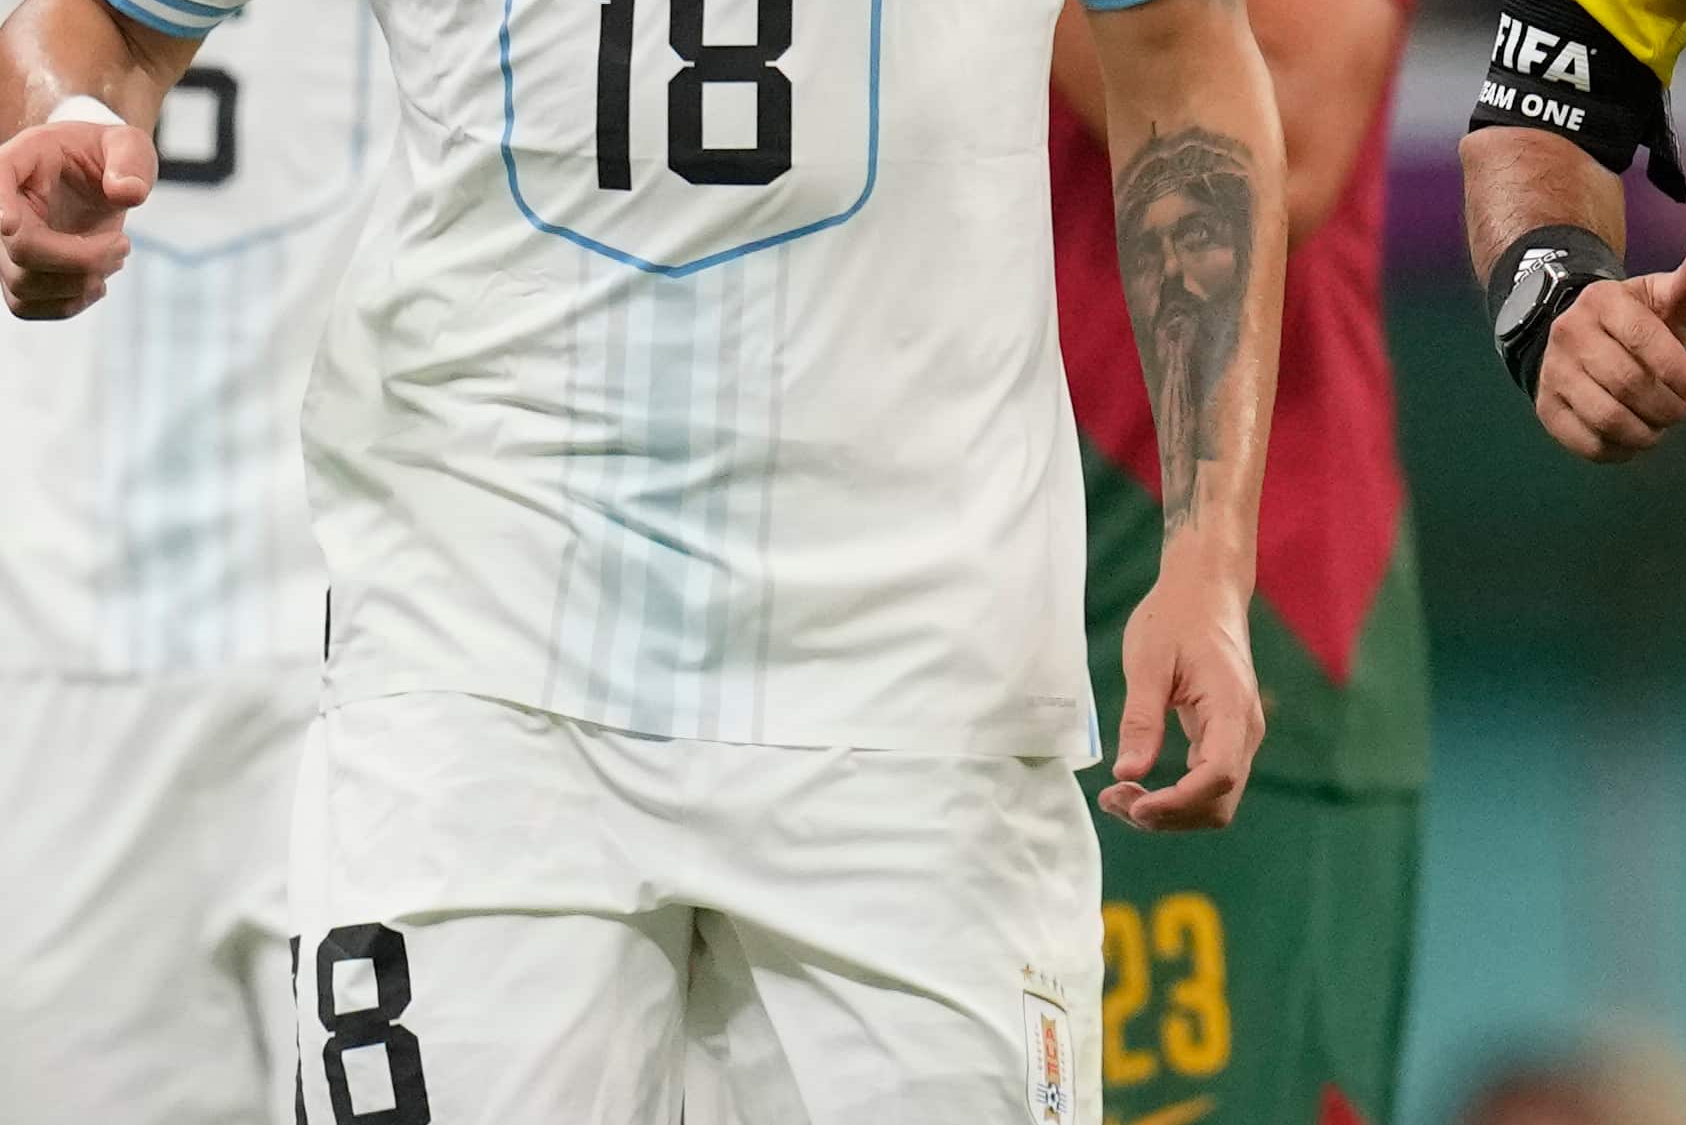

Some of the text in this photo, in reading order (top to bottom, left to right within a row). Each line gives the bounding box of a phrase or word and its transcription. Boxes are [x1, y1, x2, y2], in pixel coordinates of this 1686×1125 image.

[1491, 12, 1592, 93] FIFA
[1480, 80, 1586, 132] EAM ONE
[1102, 892, 1231, 1086] 23
